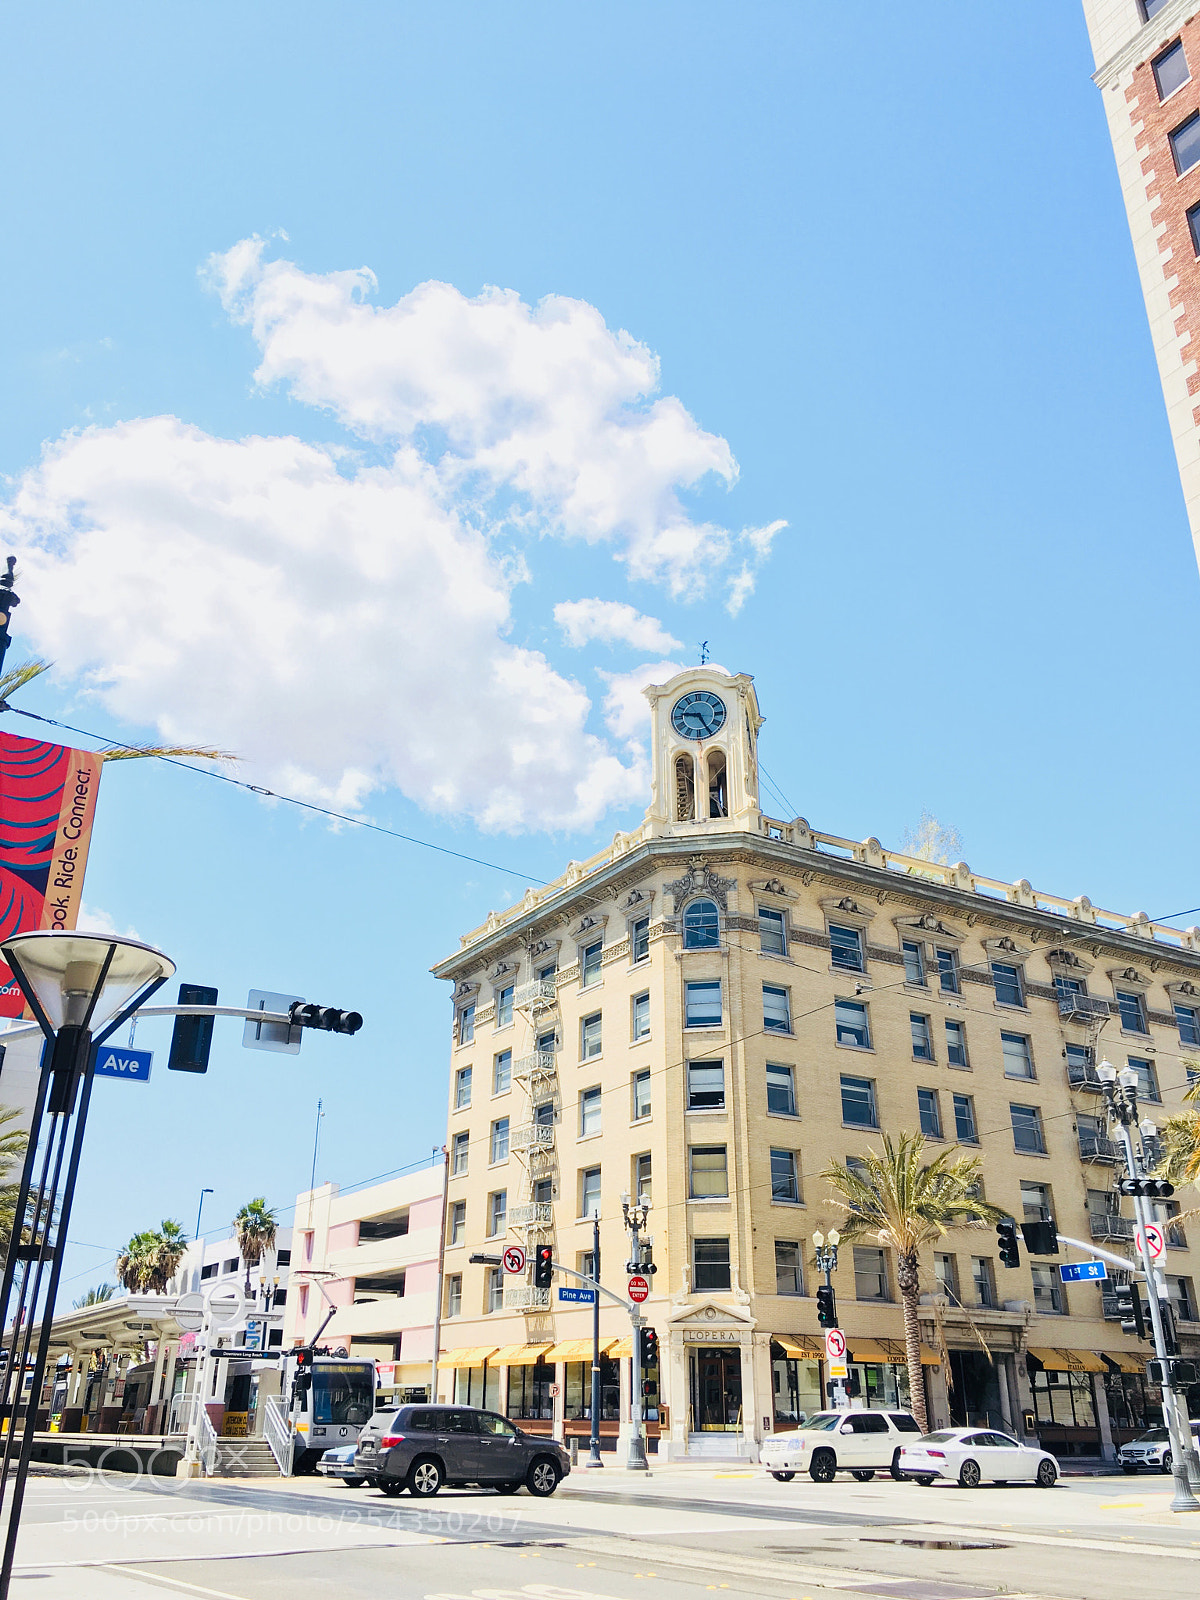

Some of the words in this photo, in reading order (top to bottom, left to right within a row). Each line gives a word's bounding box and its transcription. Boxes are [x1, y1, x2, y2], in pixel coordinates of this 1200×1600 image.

[63, 768, 92, 840] Connect.
[54, 847, 79, 888] Ride.
[50, 895, 70, 930] ook.
[102, 1054, 140, 1073] Ave
[1088, 1266, 1099, 1276] St
[562, 1291, 577, 1299] Pine
[579, 1292, 592, 1300] Ave
[689, 1331, 735, 1340] L'OPERA
